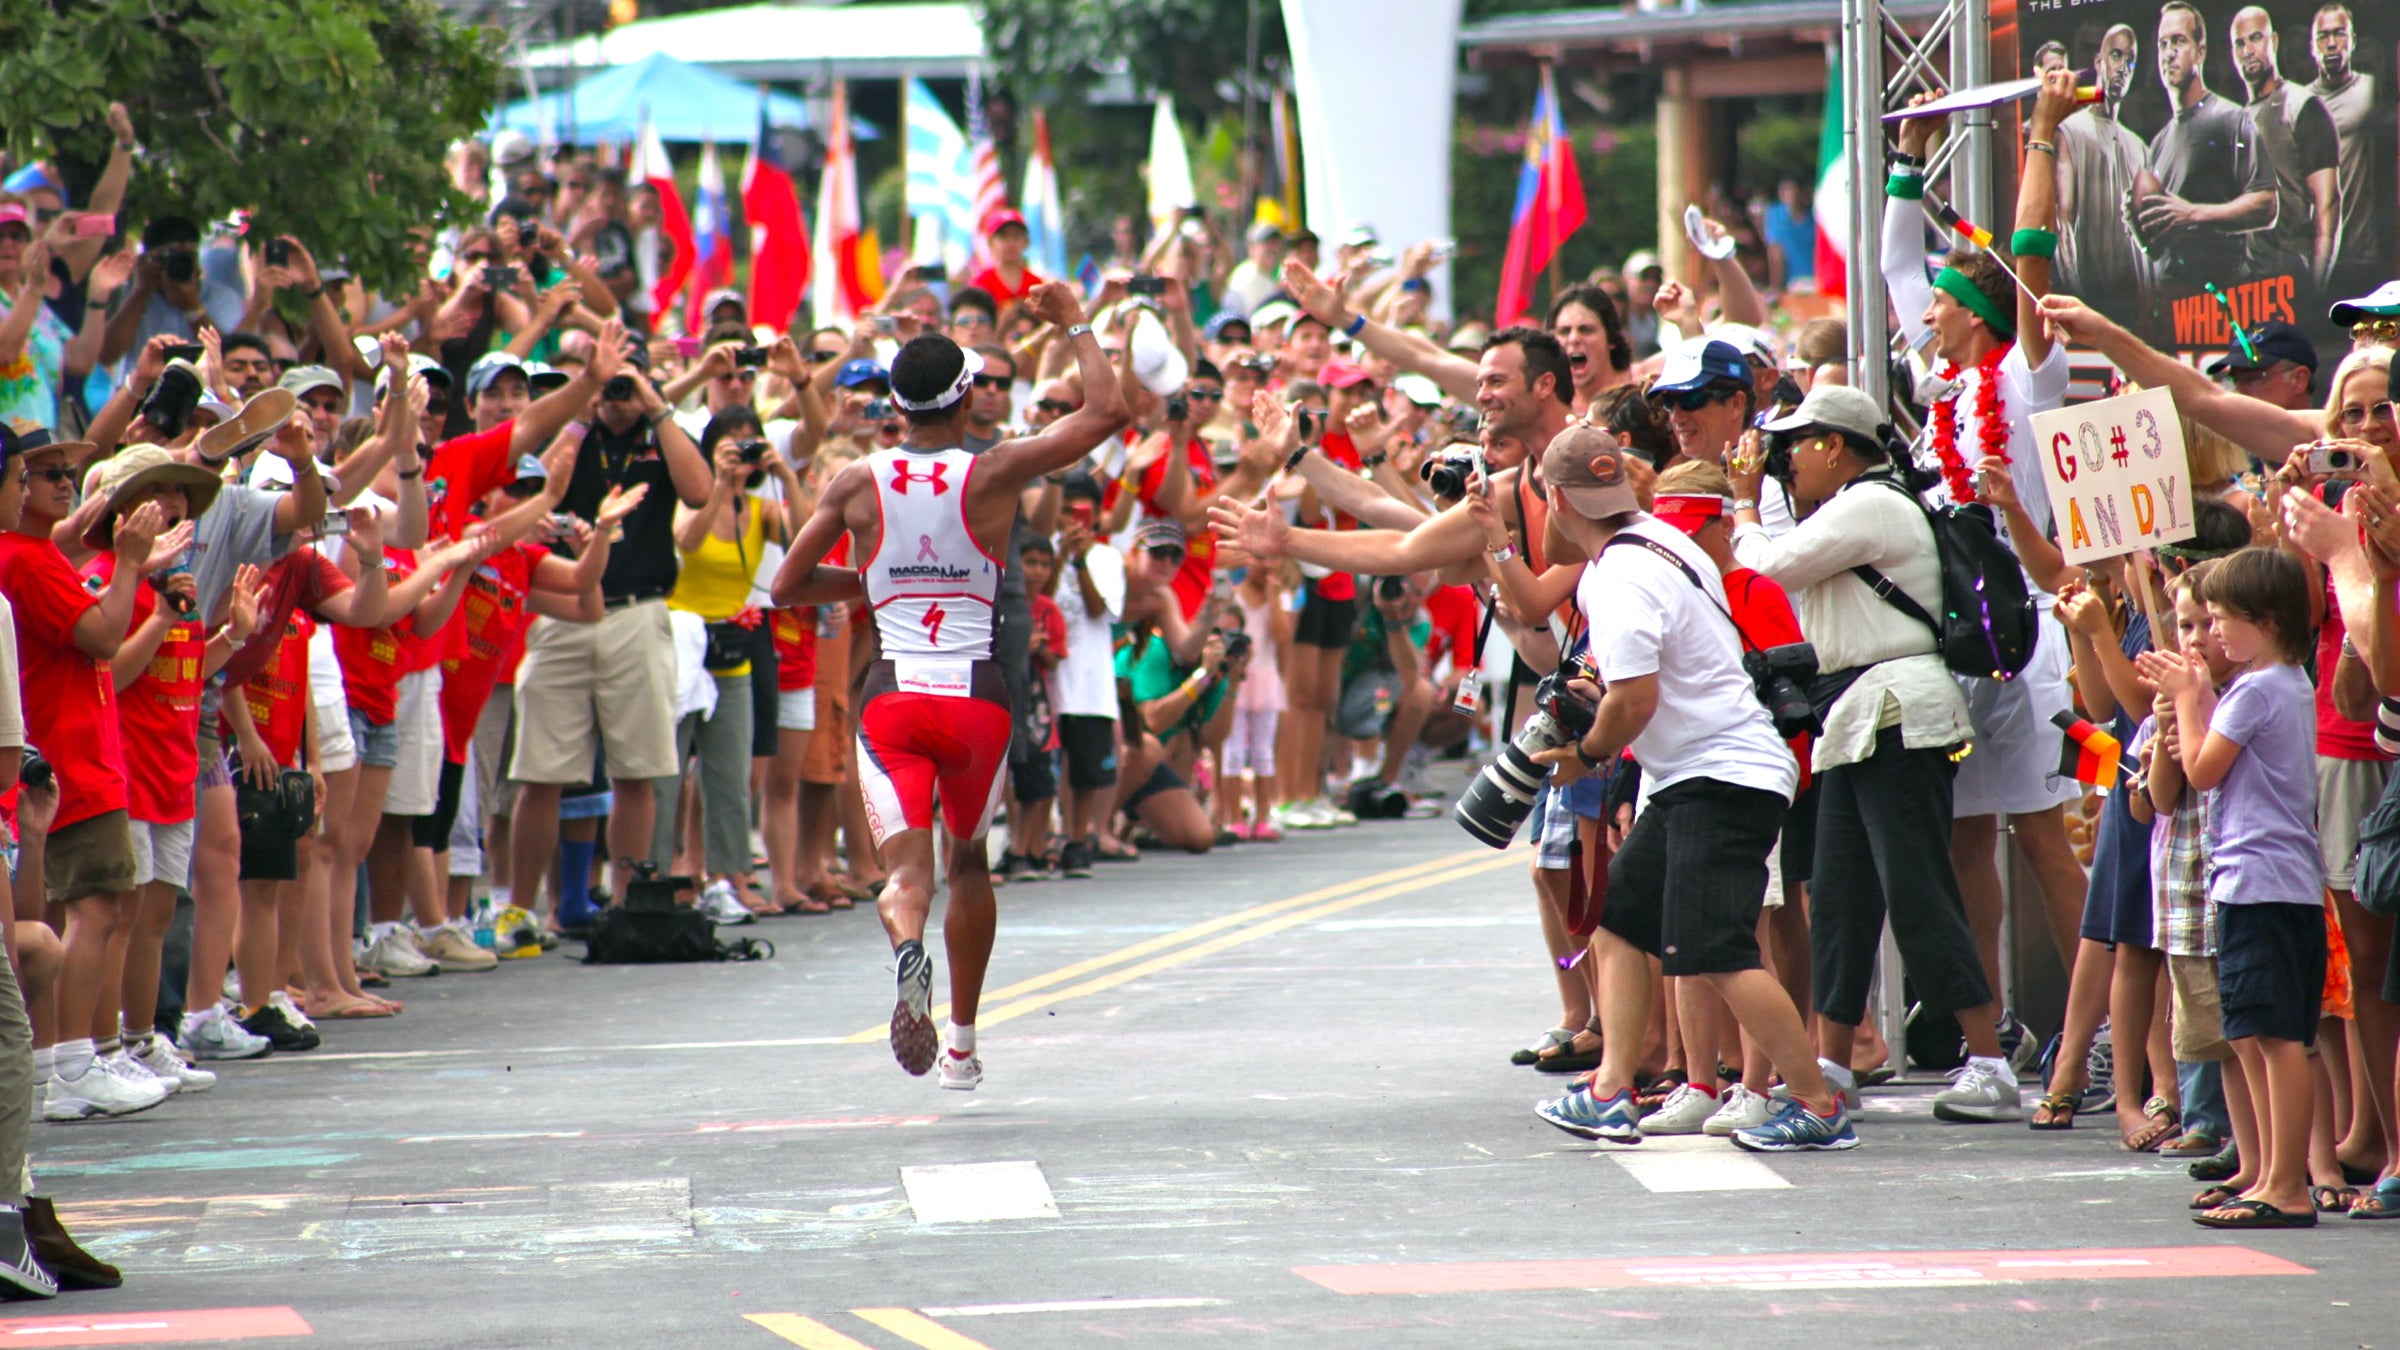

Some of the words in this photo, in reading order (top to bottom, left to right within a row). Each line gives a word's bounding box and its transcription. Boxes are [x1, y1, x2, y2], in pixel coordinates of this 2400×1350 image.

[2029, 0, 2062, 12] THE
[2172, 275, 2296, 345] WHEATIES
[2069, 475, 2176, 550] ANDY
[1645, 541, 1683, 568] Canon
[889, 566, 940, 577] MACCA
